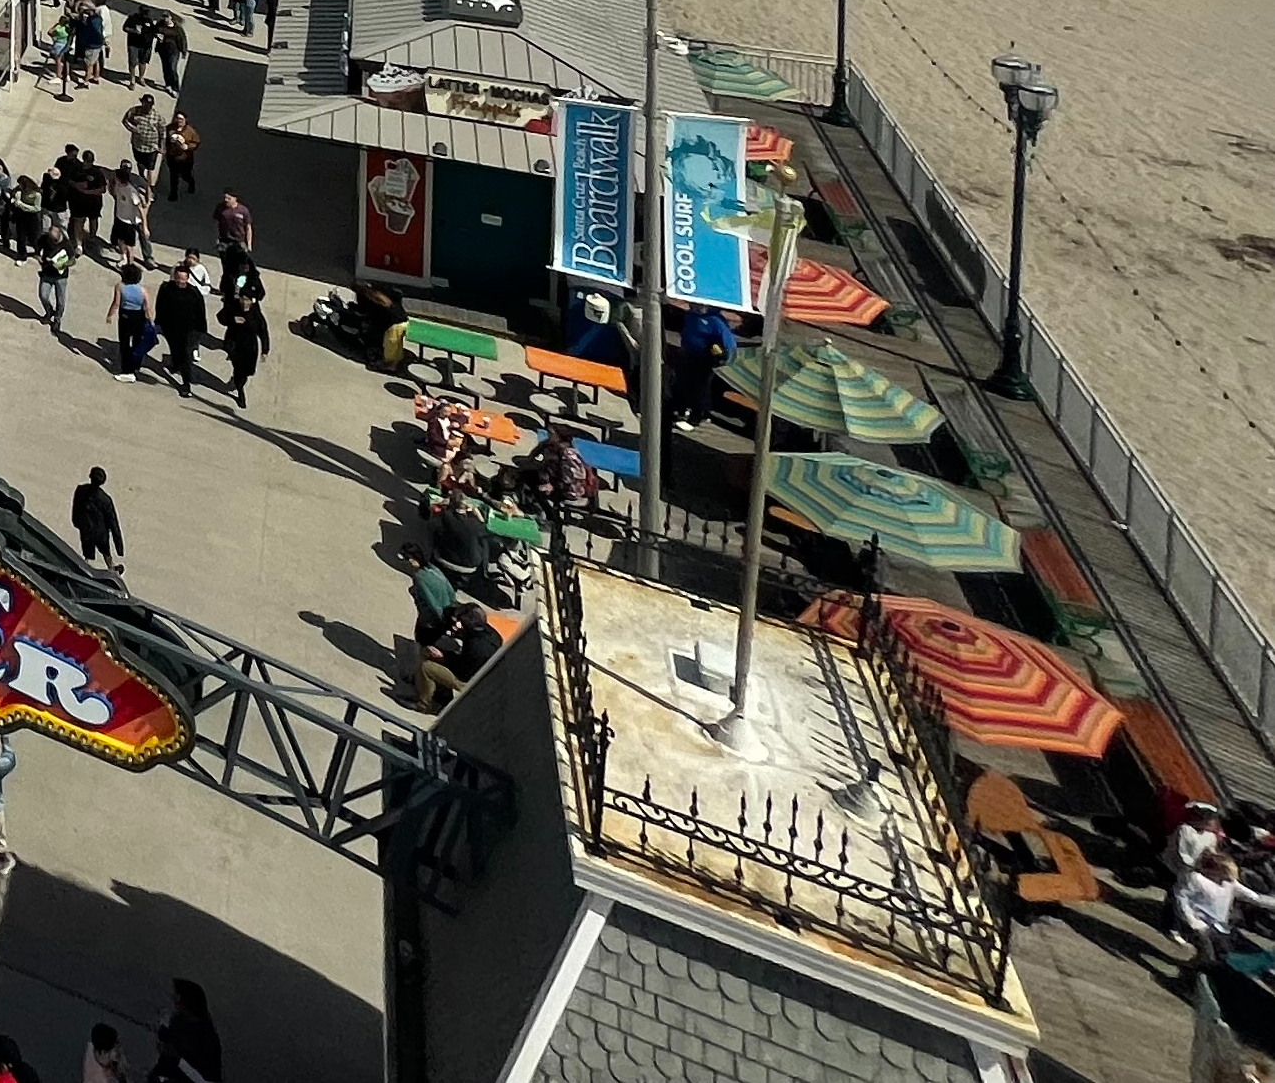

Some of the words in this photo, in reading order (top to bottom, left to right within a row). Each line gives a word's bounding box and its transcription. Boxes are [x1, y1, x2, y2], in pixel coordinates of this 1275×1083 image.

[573, 138, 587, 169] Beach
[572, 110, 621, 277] Boardwalk
[572, 179, 586, 209] Cruz
[571, 210, 586, 241] Santa
[674, 192, 695, 237] SURF
[675, 239, 697, 295] COOL
